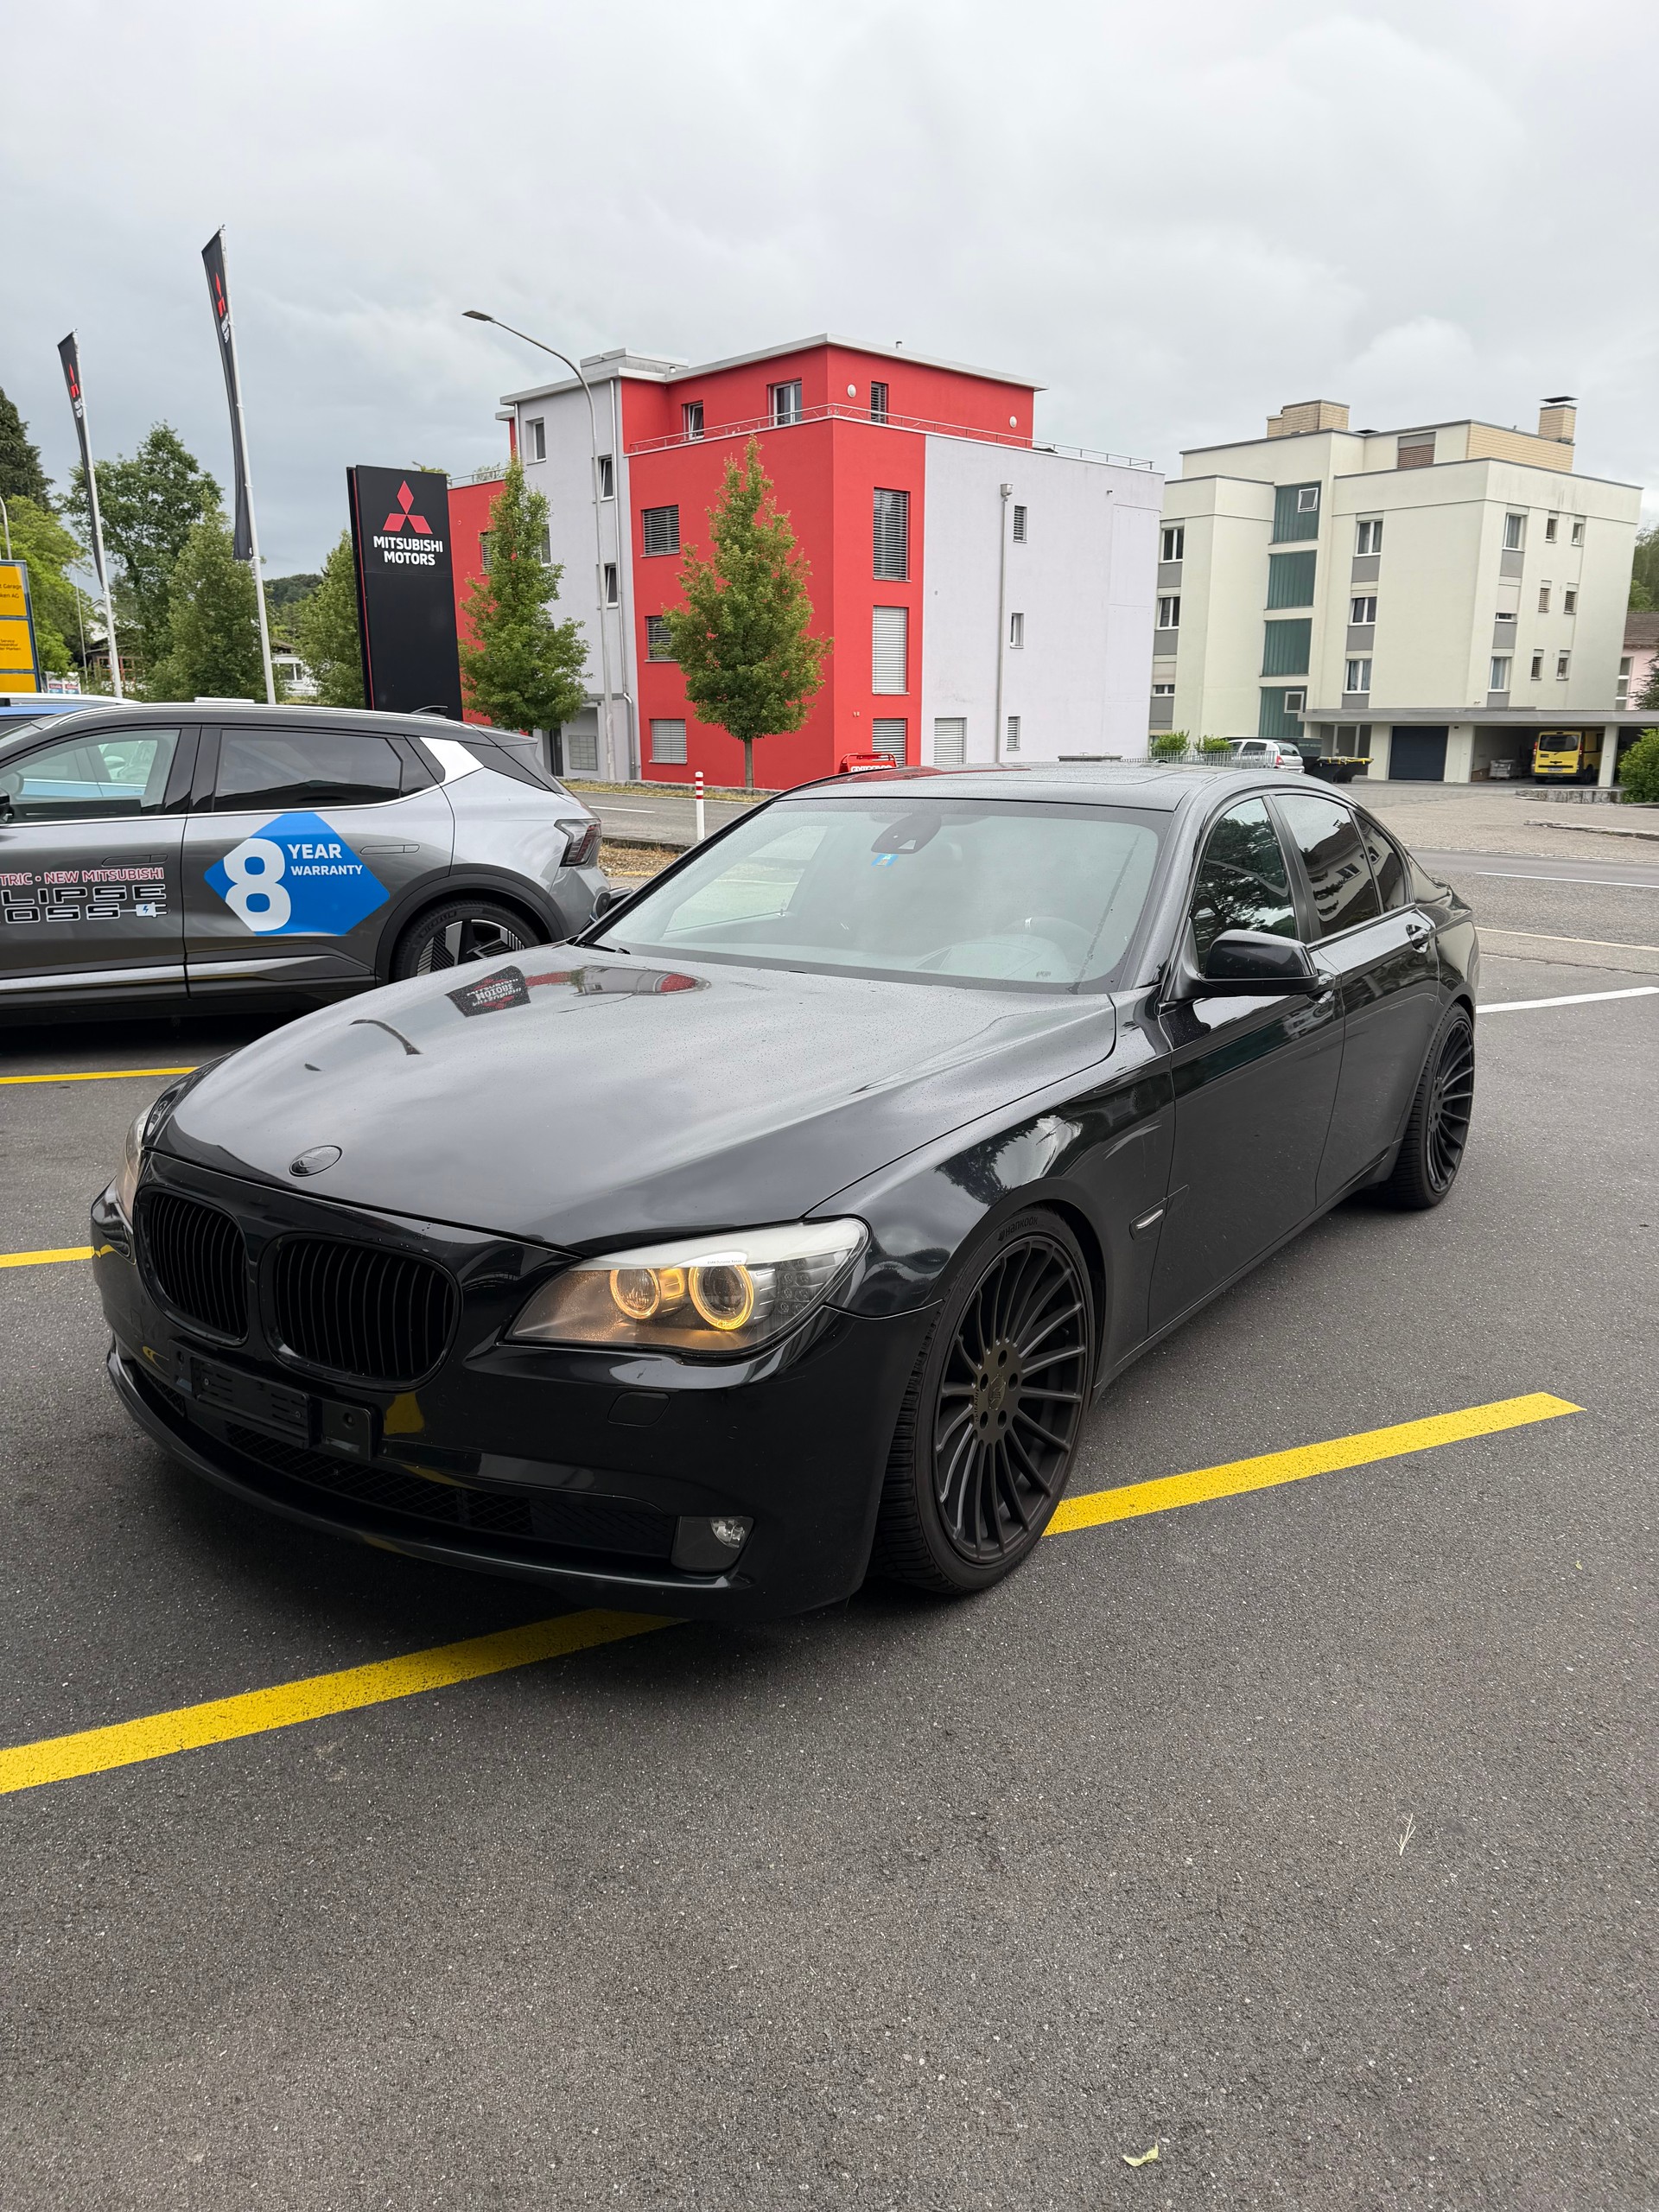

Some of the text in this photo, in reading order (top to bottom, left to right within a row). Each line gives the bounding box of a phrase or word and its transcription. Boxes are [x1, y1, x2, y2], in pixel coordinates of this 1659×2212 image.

[373, 536, 443, 553] MITSUBISHI
[384, 550, 435, 566] MOTORS
[44, 871, 79, 884] NEW
[82, 868, 164, 882] MITSUBISHI
[290, 865, 363, 875] WARRANTY
[224, 838, 342, 931] 8 YEAR
